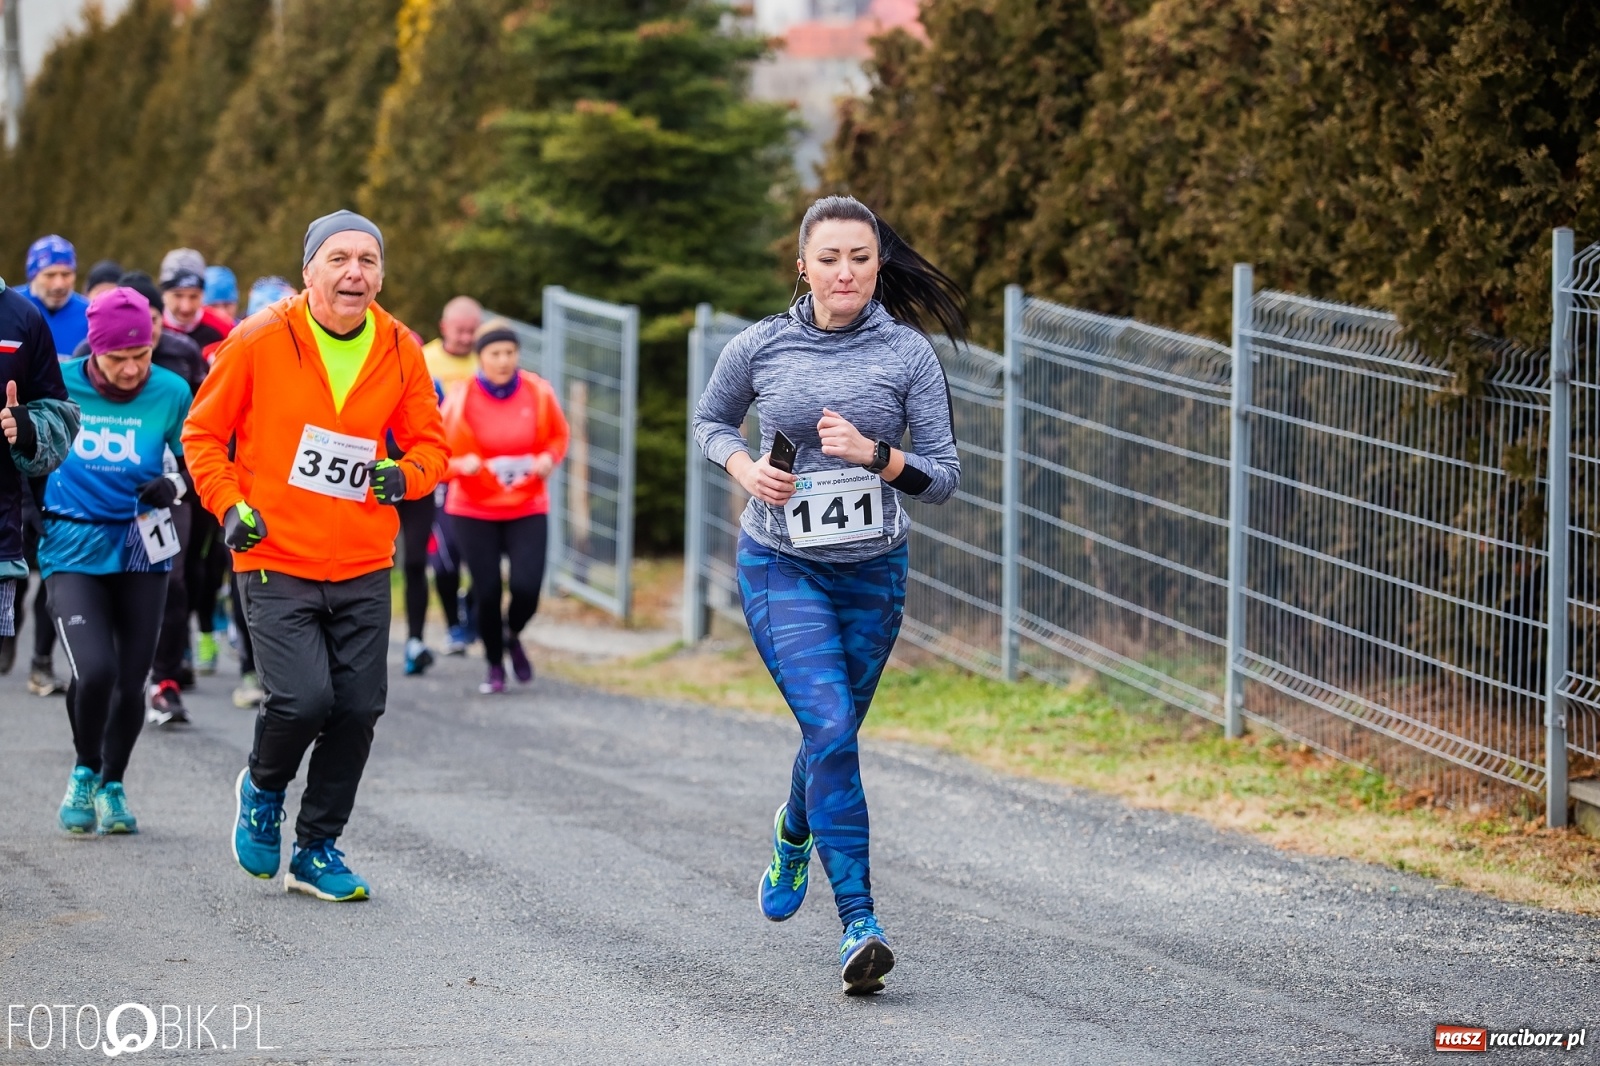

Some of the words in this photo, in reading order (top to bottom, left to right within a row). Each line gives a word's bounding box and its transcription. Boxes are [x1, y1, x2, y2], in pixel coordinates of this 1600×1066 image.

[298, 450, 368, 488] 350
[816, 474, 877, 486] www.personalbest.pl
[792, 493, 872, 533] 141
